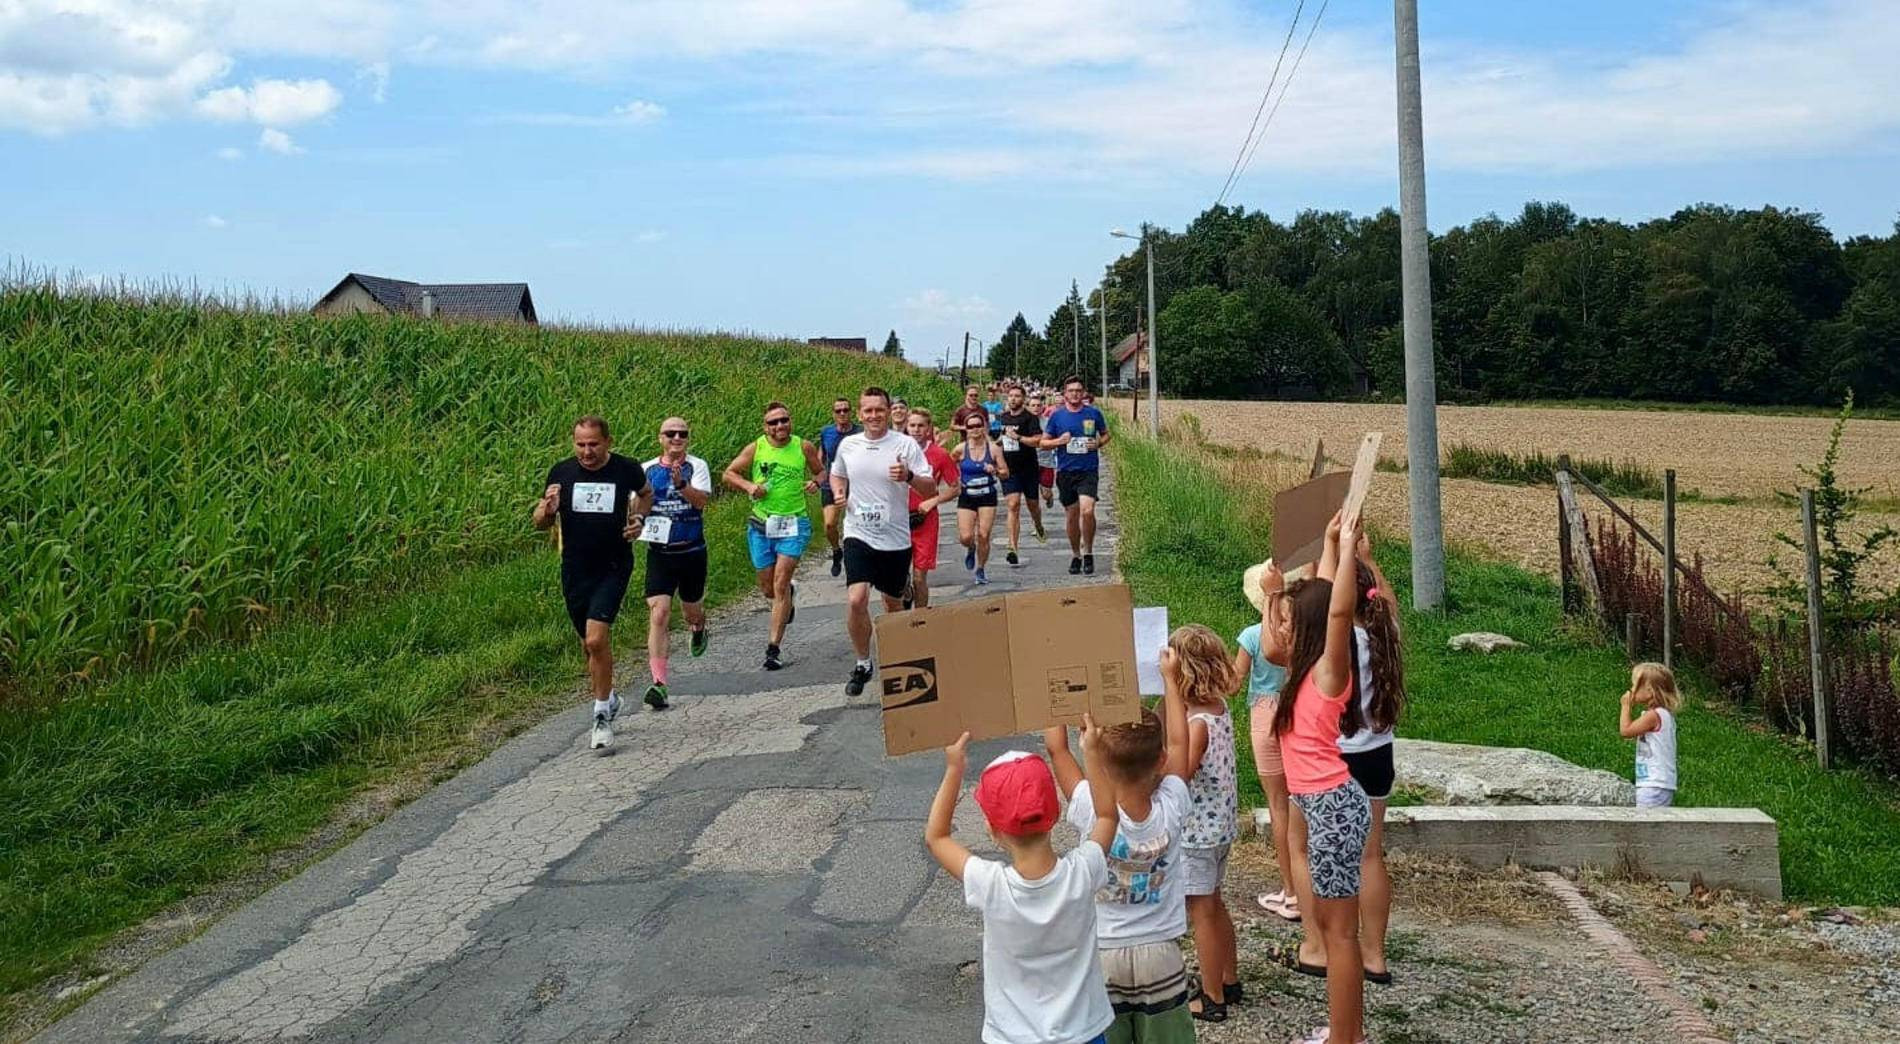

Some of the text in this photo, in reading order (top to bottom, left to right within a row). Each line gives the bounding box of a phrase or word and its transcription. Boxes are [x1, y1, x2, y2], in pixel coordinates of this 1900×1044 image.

[586, 492, 602, 504] 27
[861, 511, 881, 521] 199
[883, 673, 929, 696] EA
